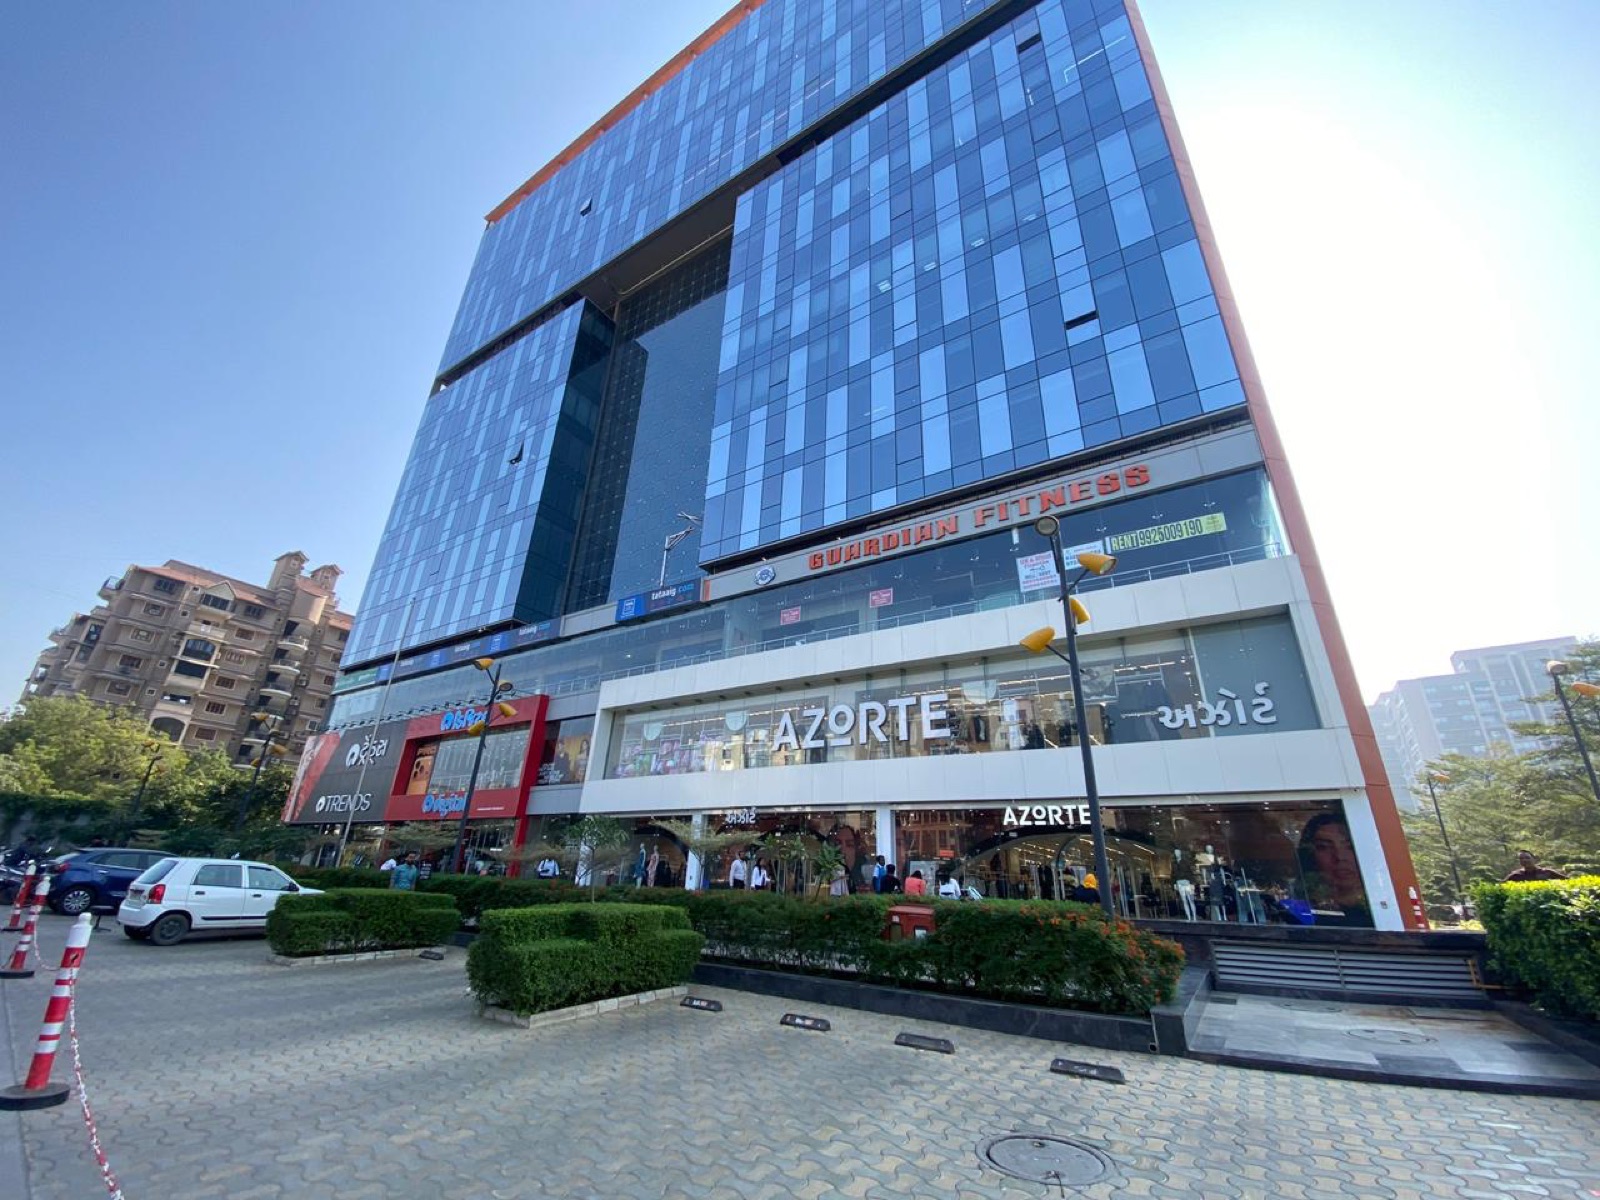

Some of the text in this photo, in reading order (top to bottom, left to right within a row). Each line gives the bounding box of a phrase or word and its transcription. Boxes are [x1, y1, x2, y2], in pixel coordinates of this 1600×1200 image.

[808, 464, 1151, 570] GUARDIAN FITNESS
[1111, 533, 1138, 551] RENT
[1139, 519, 1203, 545] 9925009190
[773, 693, 952, 752] AZORTE
[325, 793, 372, 812] TRENDS
[1002, 803, 1092, 827] AZORTE
